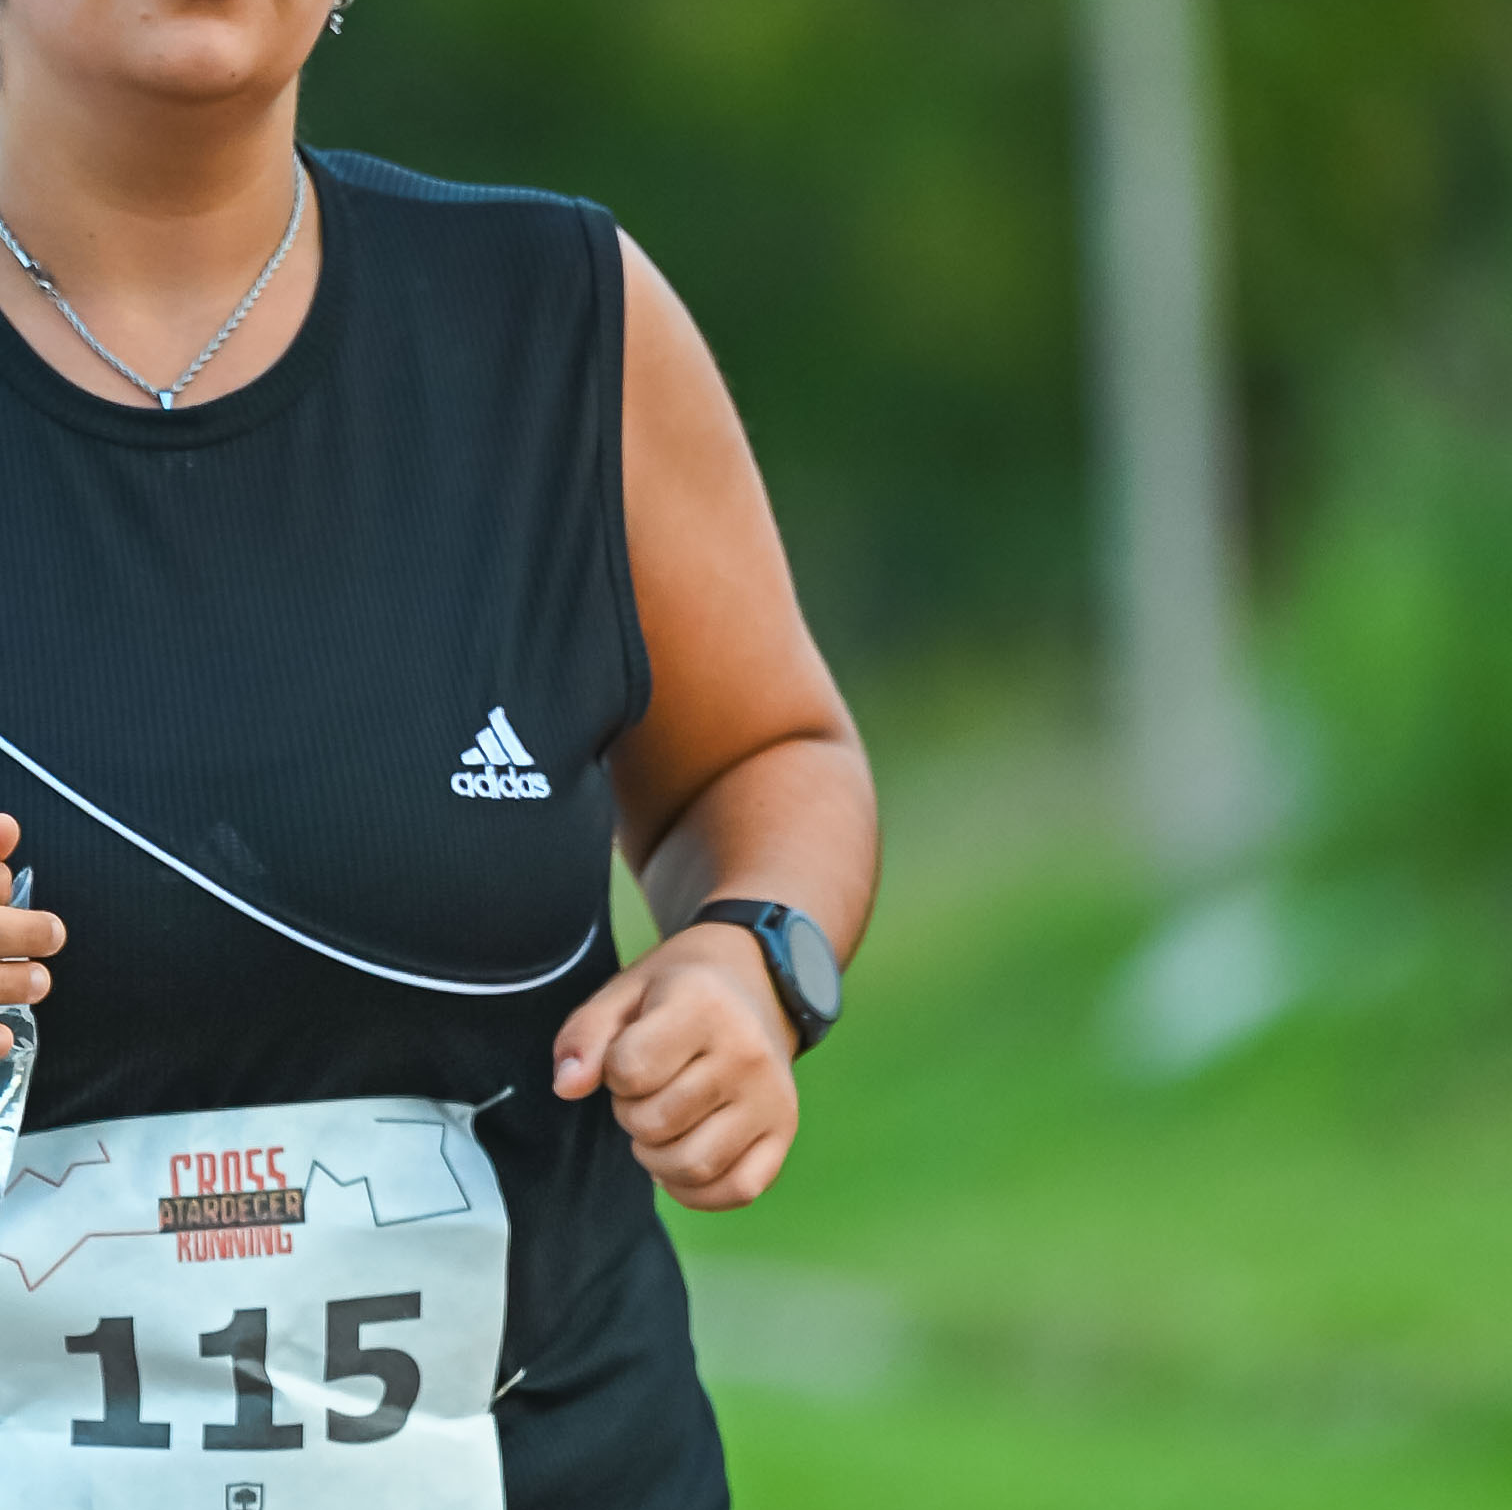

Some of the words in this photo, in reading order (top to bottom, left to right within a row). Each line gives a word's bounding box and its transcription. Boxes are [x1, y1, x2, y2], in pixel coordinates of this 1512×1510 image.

[450, 764, 552, 799] adidas
[170, 1146, 287, 1198] CROSS
[159, 1191, 302, 1229] ATARDECER
[176, 1223, 292, 1263] RUNNING
[64, 1291, 421, 1451] 115
